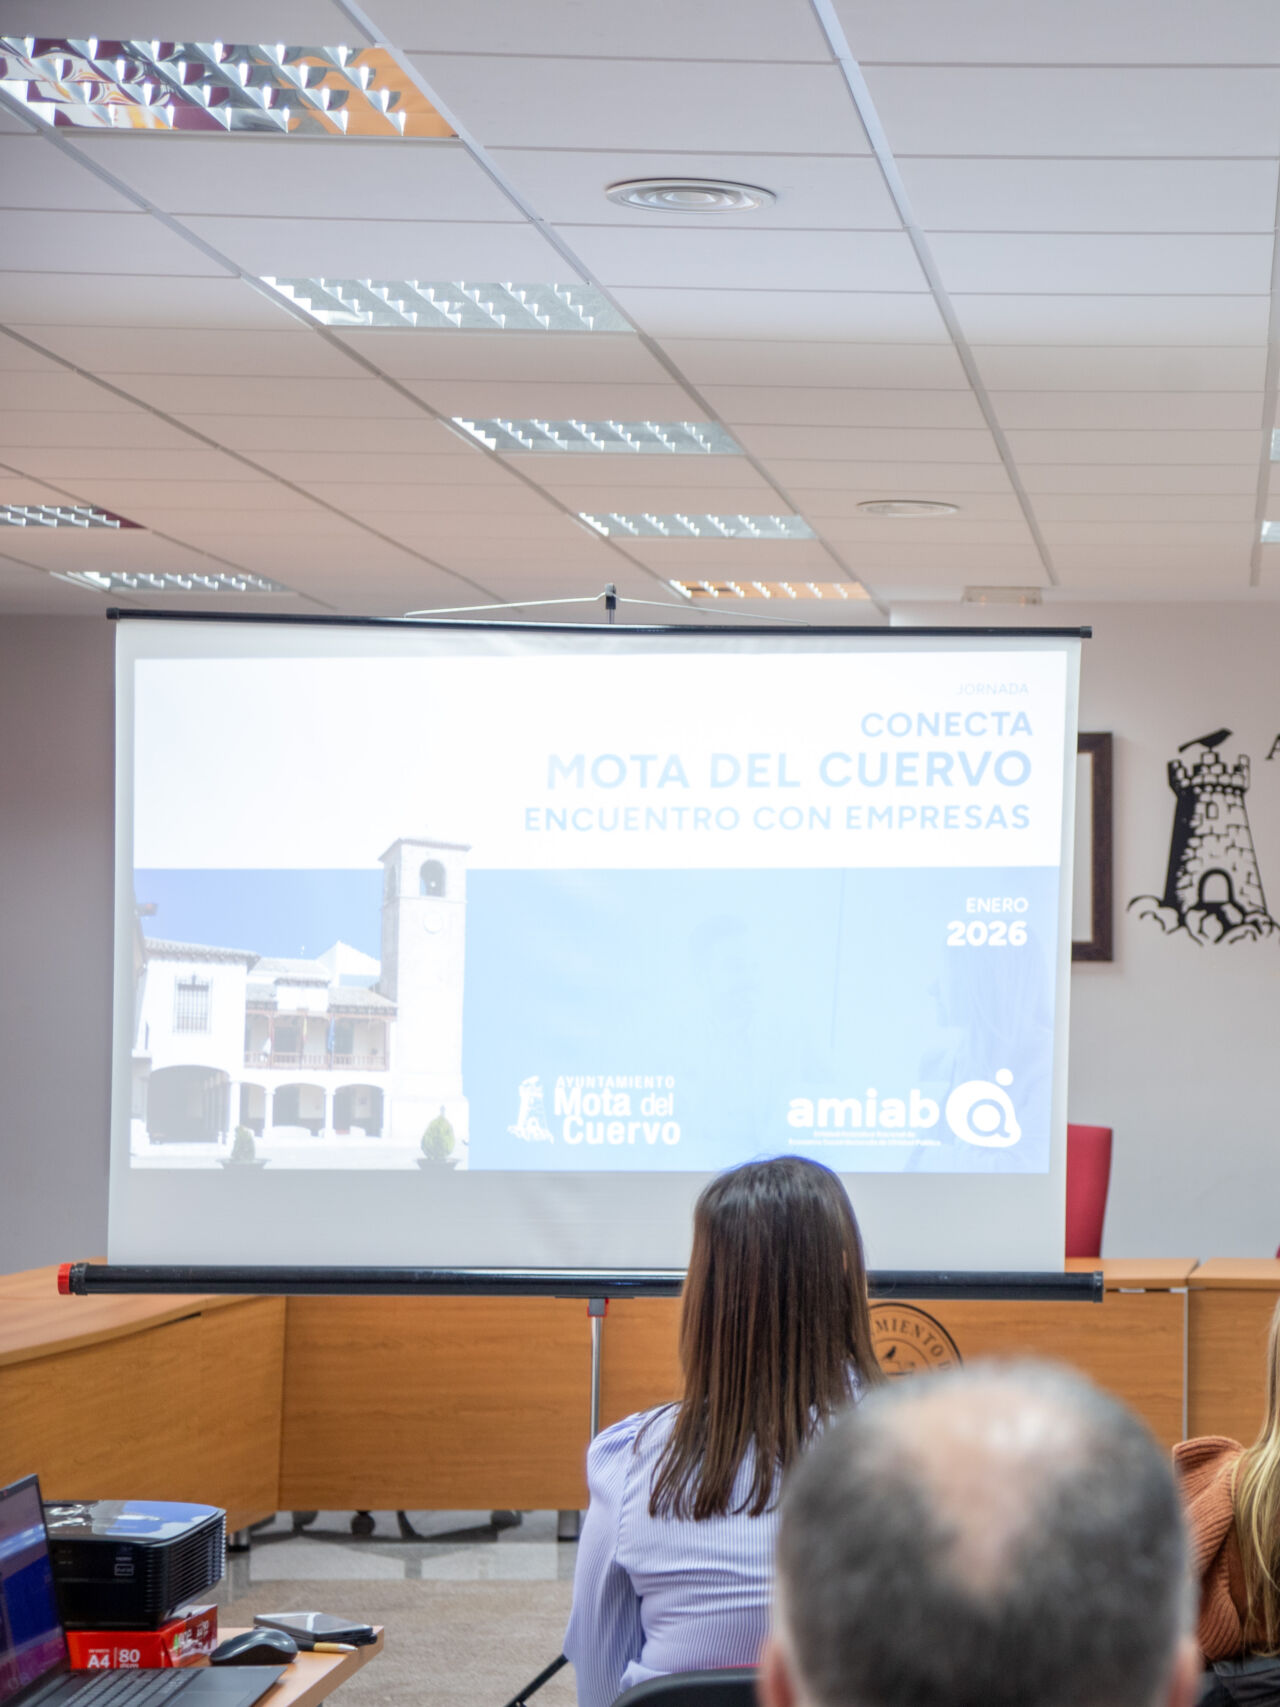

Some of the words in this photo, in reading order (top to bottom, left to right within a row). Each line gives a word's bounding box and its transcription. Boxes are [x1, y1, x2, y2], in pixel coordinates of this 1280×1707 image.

[956, 682, 1030, 696] JORNADA
[860, 711, 1033, 738] CONECTA
[546, 753, 691, 790] MOTA
[709, 752, 802, 789] DEL
[819, 749, 1032, 788] CUERVO
[524, 806, 741, 833] ENCUENTRO
[752, 805, 831, 831] CON
[845, 804, 1031, 830] EMPRESAS
[965, 896, 1030, 913] ENERO
[946, 919, 1028, 947] 2026
[555, 1075, 675, 1089] AYUNTAMIENTO
[553, 1088, 632, 1117] Mota
[640, 1092, 674, 1117] del
[786, 1087, 940, 1129] amiab
[562, 1115, 681, 1145] Cuervo
[87, 1654, 110, 1668] A4
[118, 1649, 140, 1663] 80
